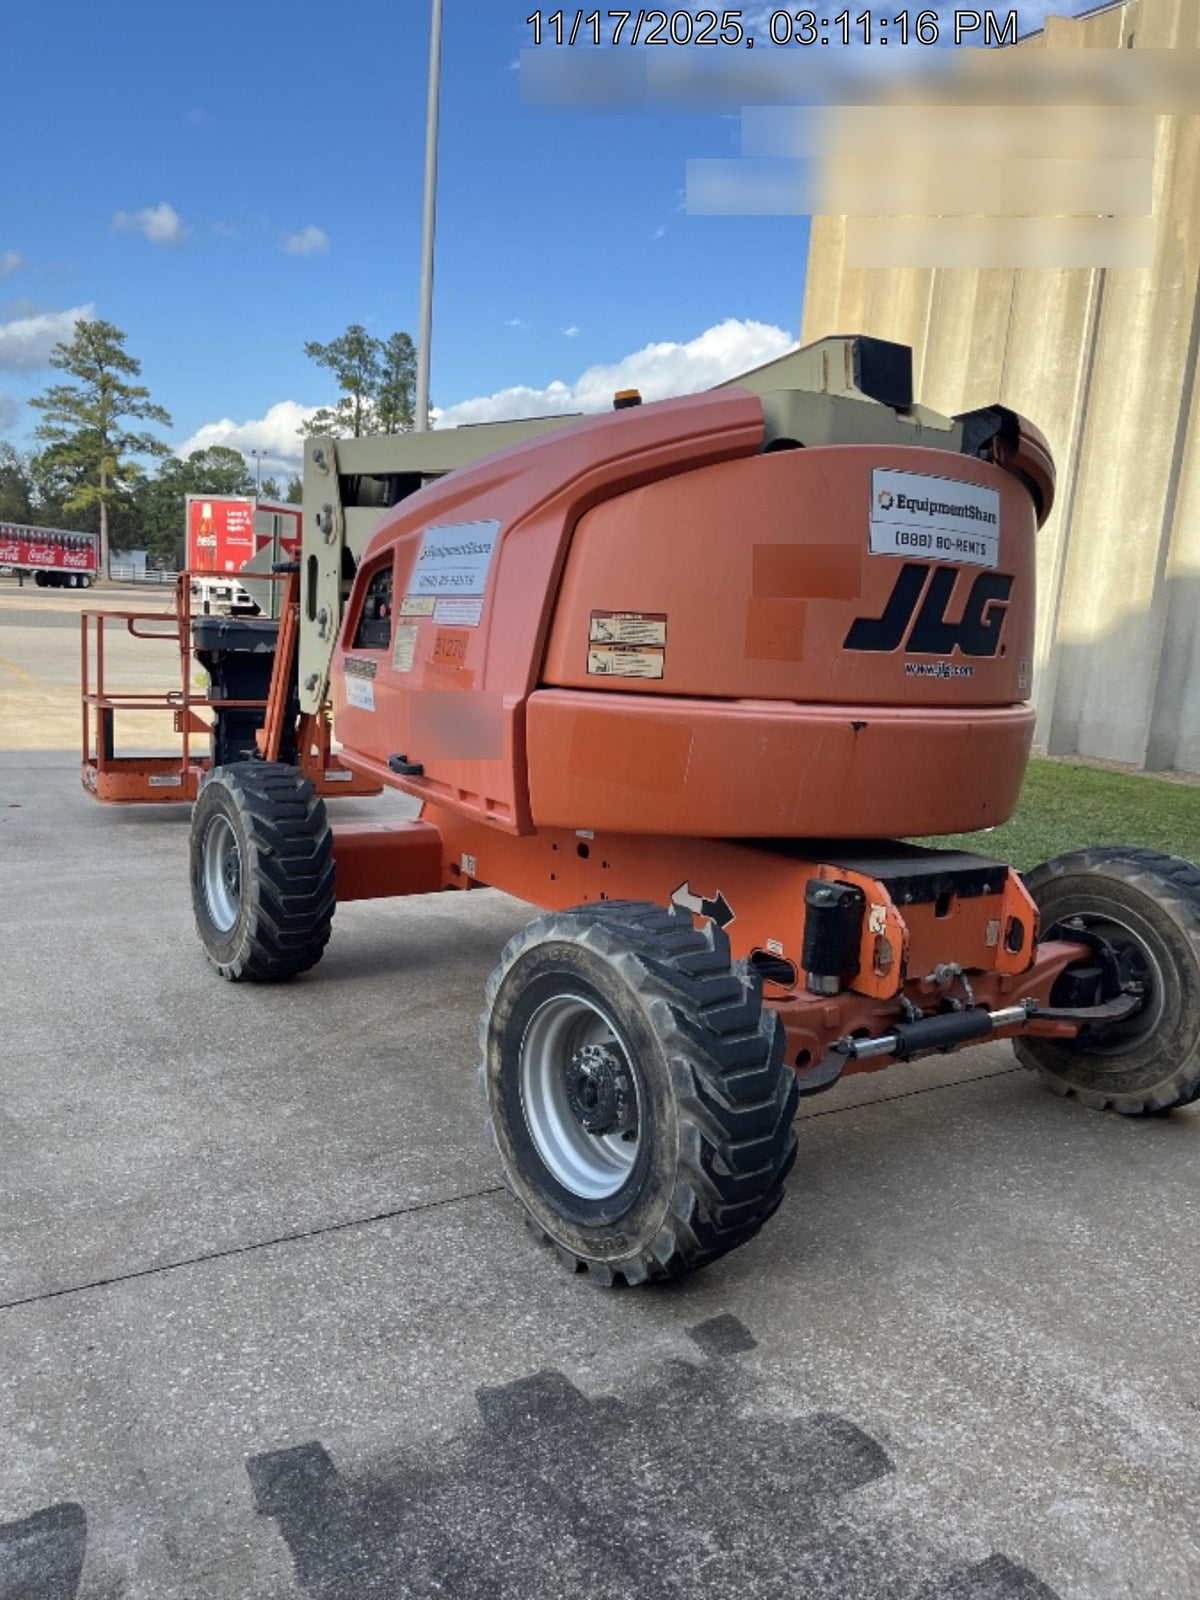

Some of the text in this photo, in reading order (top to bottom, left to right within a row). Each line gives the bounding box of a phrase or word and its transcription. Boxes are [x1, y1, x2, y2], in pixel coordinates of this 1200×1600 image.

[896, 494, 997, 525] EquipmentShare
[895, 531, 932, 549] (888)
[843, 563, 1015, 657] JLG
[905, 662, 974, 678] www.jlg.com
